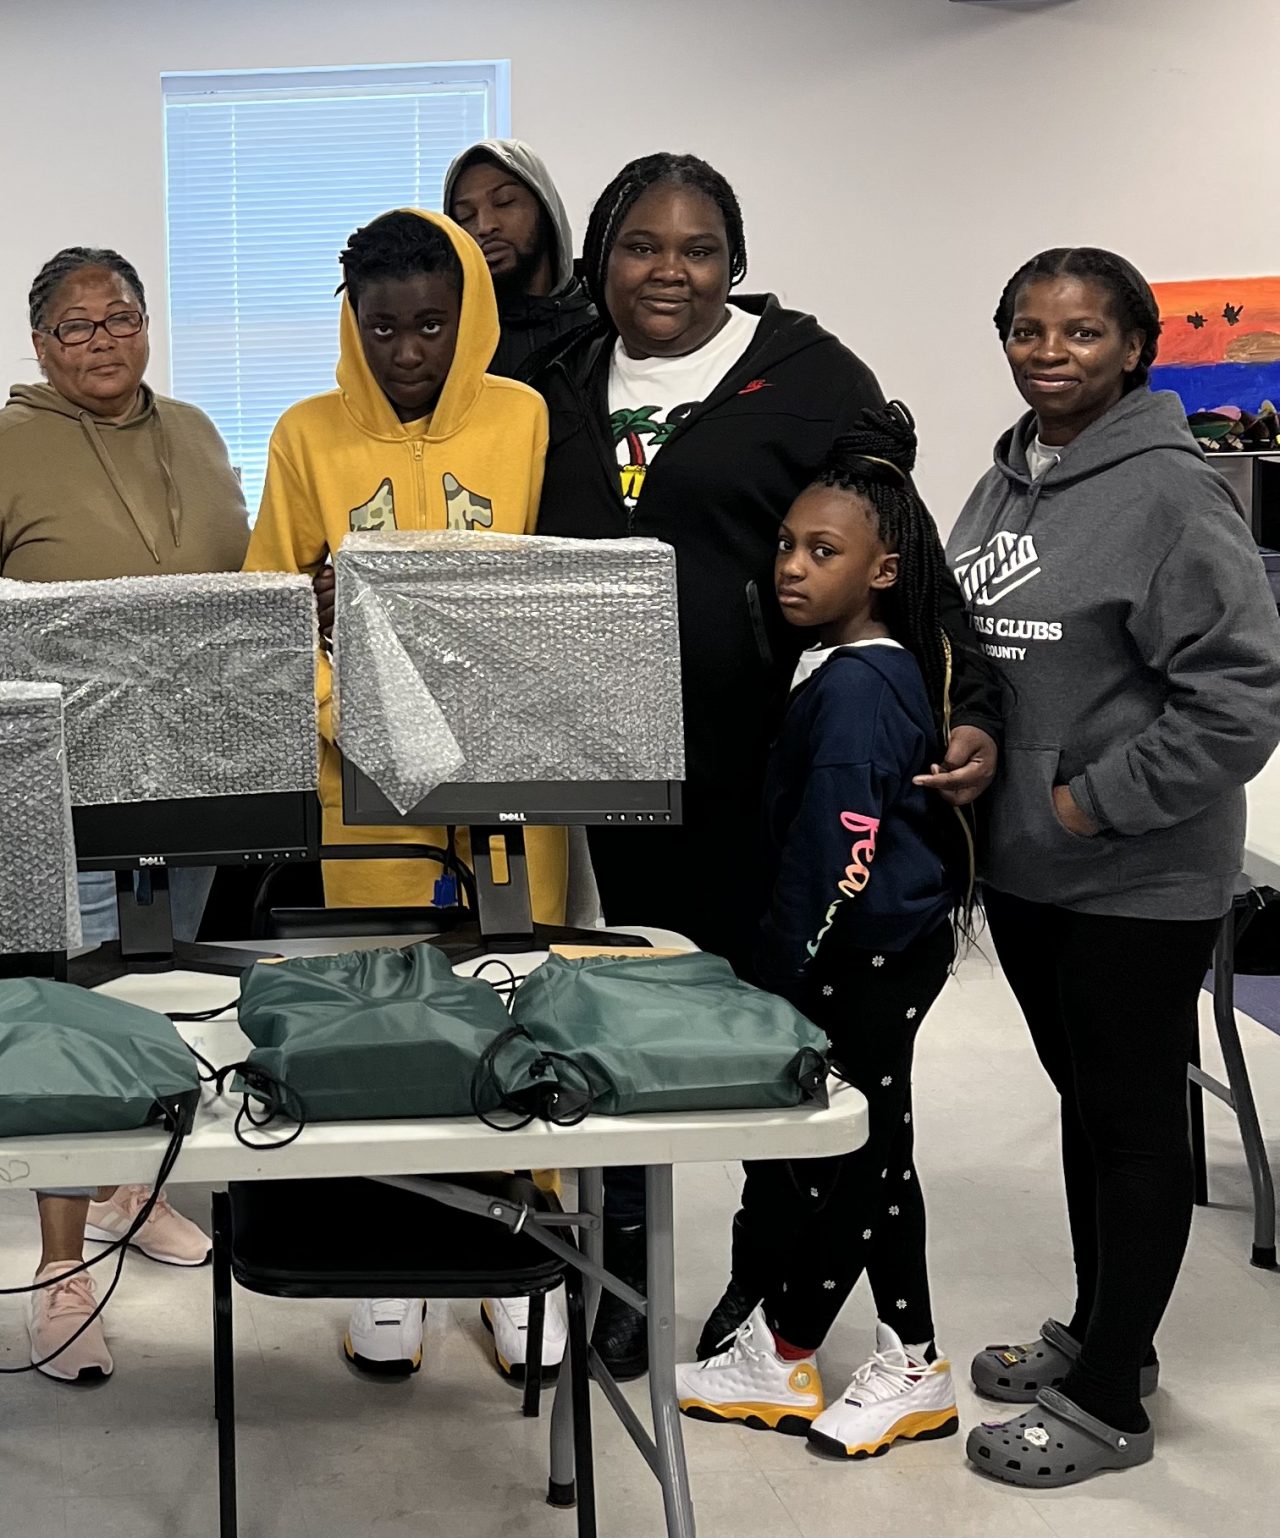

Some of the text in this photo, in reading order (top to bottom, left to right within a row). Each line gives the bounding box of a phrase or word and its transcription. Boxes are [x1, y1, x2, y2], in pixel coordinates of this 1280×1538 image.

[995, 617, 1063, 641] CLUBS
[984, 643, 1027, 661] COUNTY
[499, 811, 527, 822] DELL
[139, 856, 166, 867] DELL
